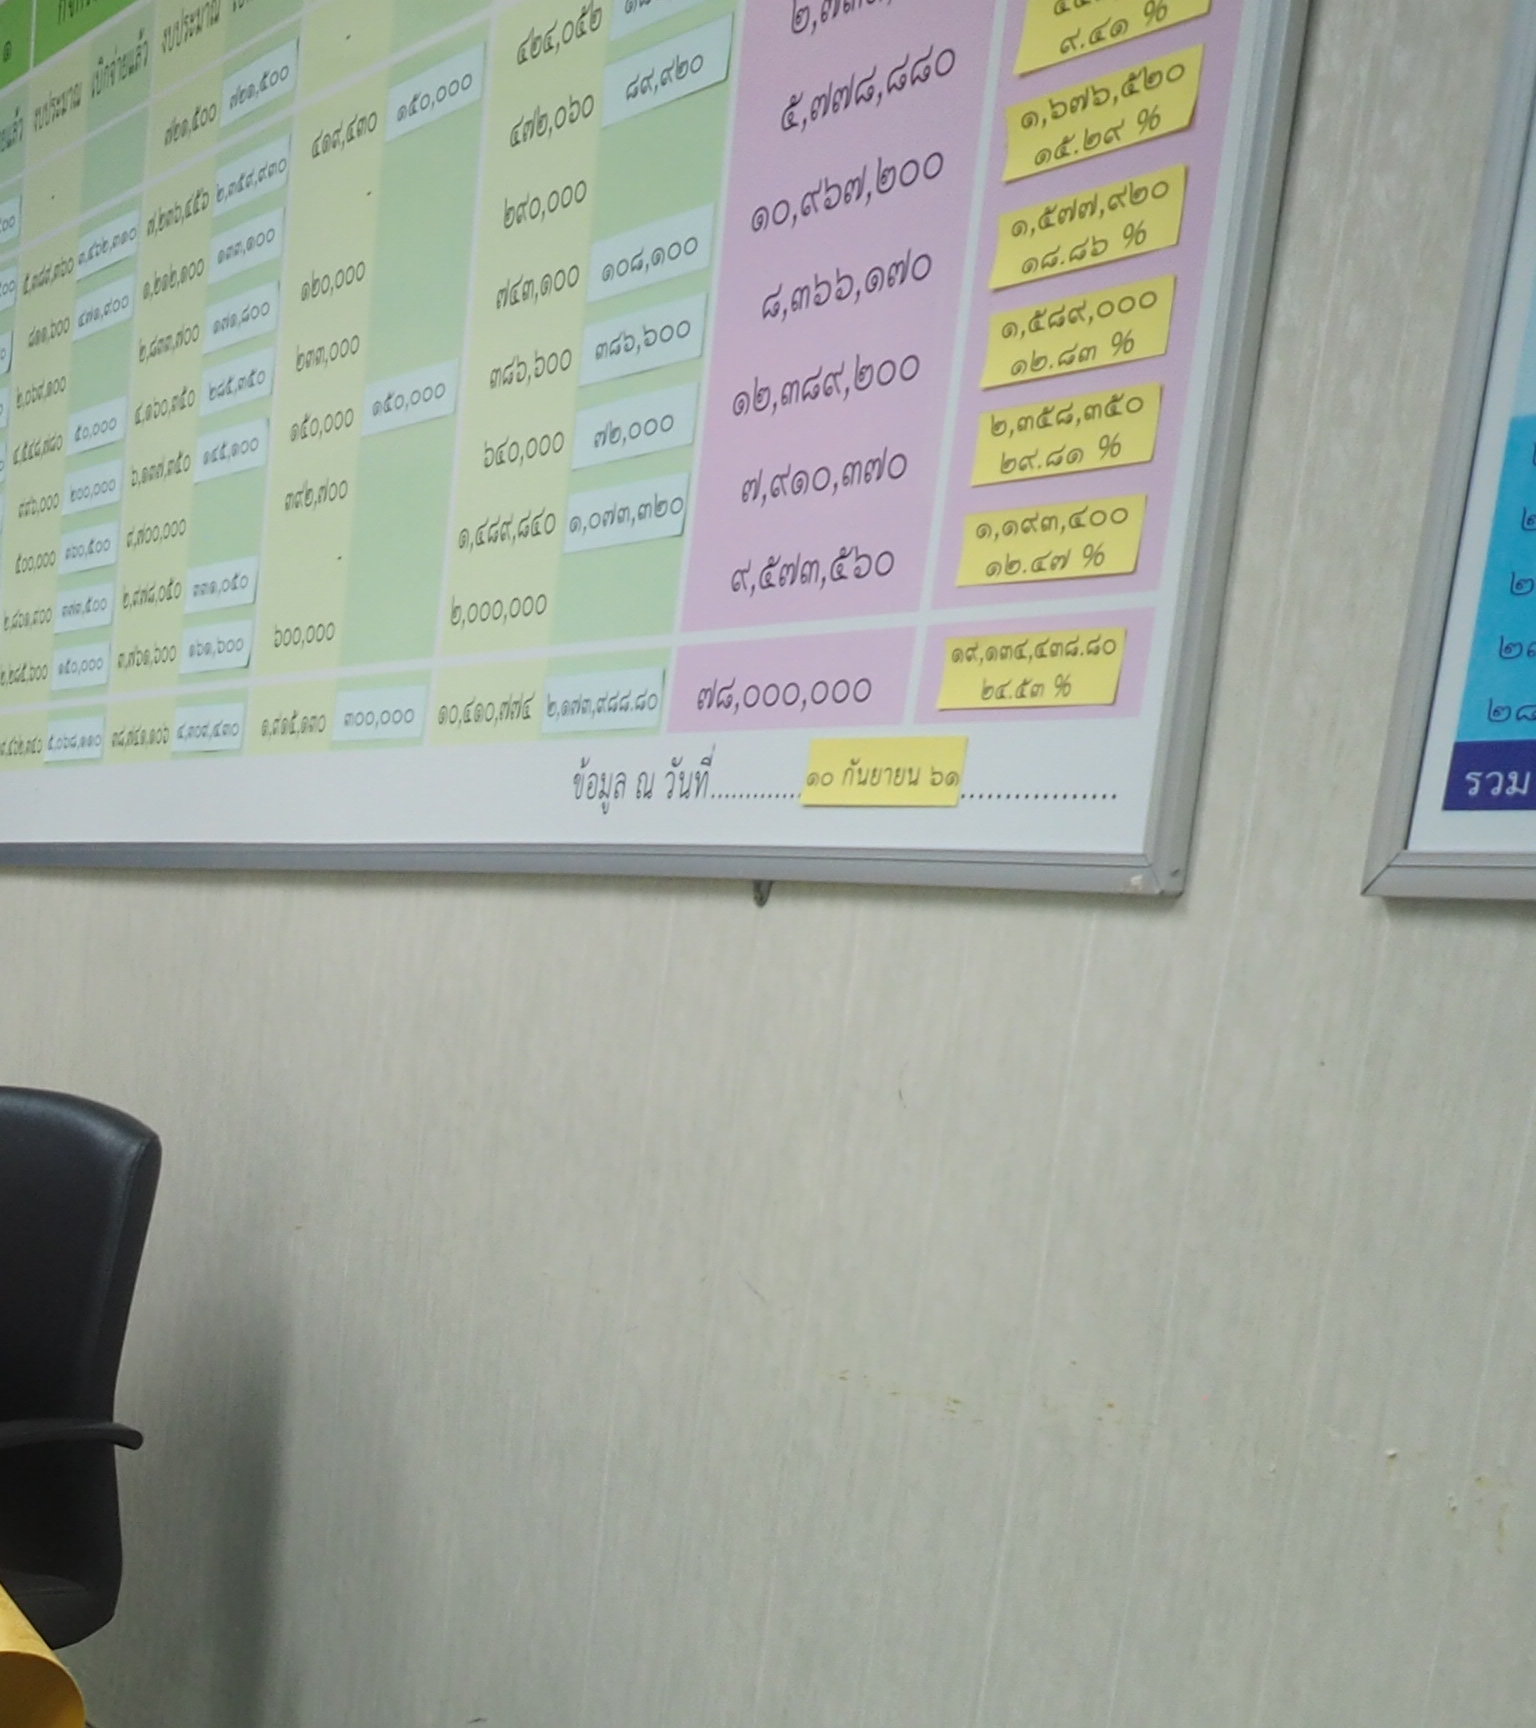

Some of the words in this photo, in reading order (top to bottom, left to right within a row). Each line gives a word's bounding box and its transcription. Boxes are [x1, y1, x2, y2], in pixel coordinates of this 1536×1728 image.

[1059, 17, 1129, 55] ๙.๔๑
[1143, 0, 1168, 23] %
[310, 110, 378, 160] ๔๑๙,๔๓๐
[395, 71, 474, 123] ๑๕๐,๐๐๐
[516, 5, 602, 65] ๔๒๔,๐๕๒
[508, 92, 595, 149] ๔๗๒,๐๖๐
[625, 53, 704, 99] ๘๙,๙๒๐
[1019, 61, 1186, 131] ๑,๖๗๖,๕๒๐
[1033, 122, 1125, 167] ๑๕.๒๙
[1136, 104, 1161, 137] %
[299, 259, 366, 303] ๑๒๐,๐๐๐
[502, 178, 588, 231] ๒๙๐,๐๐๐
[780, 46, 957, 134] ๕,๗๗๘,๘๘๐
[1009, 179, 1171, 239] ๑,๕๗๗,๙๒๐
[1020, 234, 1109, 277] ๑๘.๘๖
[1121, 219, 1147, 249] %
[73, 416, 118, 444] ๕๐,๐๐๐
[294, 333, 361, 374] ๒๓๓,๐๐๐
[494, 262, 581, 311] ๗๔๓,๑๐๐
[601, 236, 699, 282] ๑๐๘,๑๐๐
[750, 151, 945, 234] ๑๐,๙๖๗,๒๐๐
[1000, 289, 1159, 342] ๑,๕๘๙,๐๐๐
[68, 477, 117, 504] ๒๐๐,๐๐๐
[289, 406, 355, 444] ๑๕๐,๐๐๐
[371, 381, 447, 418] ๑๕๐,๐๐๐
[488, 346, 573, 390] ๓๘๖,๖๐๐
[594, 319, 692, 361] ๓๘๖,๖๐๐
[760, 253, 933, 323] ๘,๓๖๖,๑๗๐
[1009, 341, 1098, 378] ๑๒.๘๓
[1110, 330, 1135, 358] %
[283, 478, 349, 512] ๓๙๒,๗๐๐
[482, 429, 566, 470] ๖๔๐,๐๐๐
[593, 413, 675, 449] ๗๒,๐๐๐
[731, 352, 921, 418] ๑๒,๓๘๙,๒๐๐
[990, 391, 1145, 440] ๒,๓๕๘,๓๕๐
[998, 443, 1084, 477] ๒๙.๘๑
[1097, 434, 1122, 459] %
[457, 507, 557, 551] ๑,๔๘๙,๘๔๐
[568, 491, 685, 534] ๑,๐๗๓,๓๒๐
[740, 447, 909, 507] ๗,๙๑๐,๓๗๐
[975, 505, 1129, 542] ๑,๑๙๓,๔๐๐
[984, 552, 1070, 579] ๑๒.๔๗
[1082, 543, 1105, 570] %
[272, 620, 336, 650] ๖๐๐,๐๐๐
[449, 592, 548, 628] ๒,๐๐๐,๐๐๐
[729, 546, 896, 598] ๙,๕๗๓,๕๖๐
[951, 637, 1118, 666] ๑๙,๑๓๔,๔๓๘.๘๐
[342, 706, 416, 729] ๓๐๐,๐๐๐
[436, 692, 535, 727] ๑๐,๔๑๐,๗๗๔
[695, 676, 873, 718] ๗๘,๐๐๐,๐๐๐
[980, 674, 1046, 702] ๒๔.๕๓
[1052, 674, 1072, 698] %
[572, 757, 627, 815] ข้อมูล
[634, 768, 655, 801] ณ
[663, 744, 718, 801] วันที่
[841, 757, 922, 787] กันยายน
